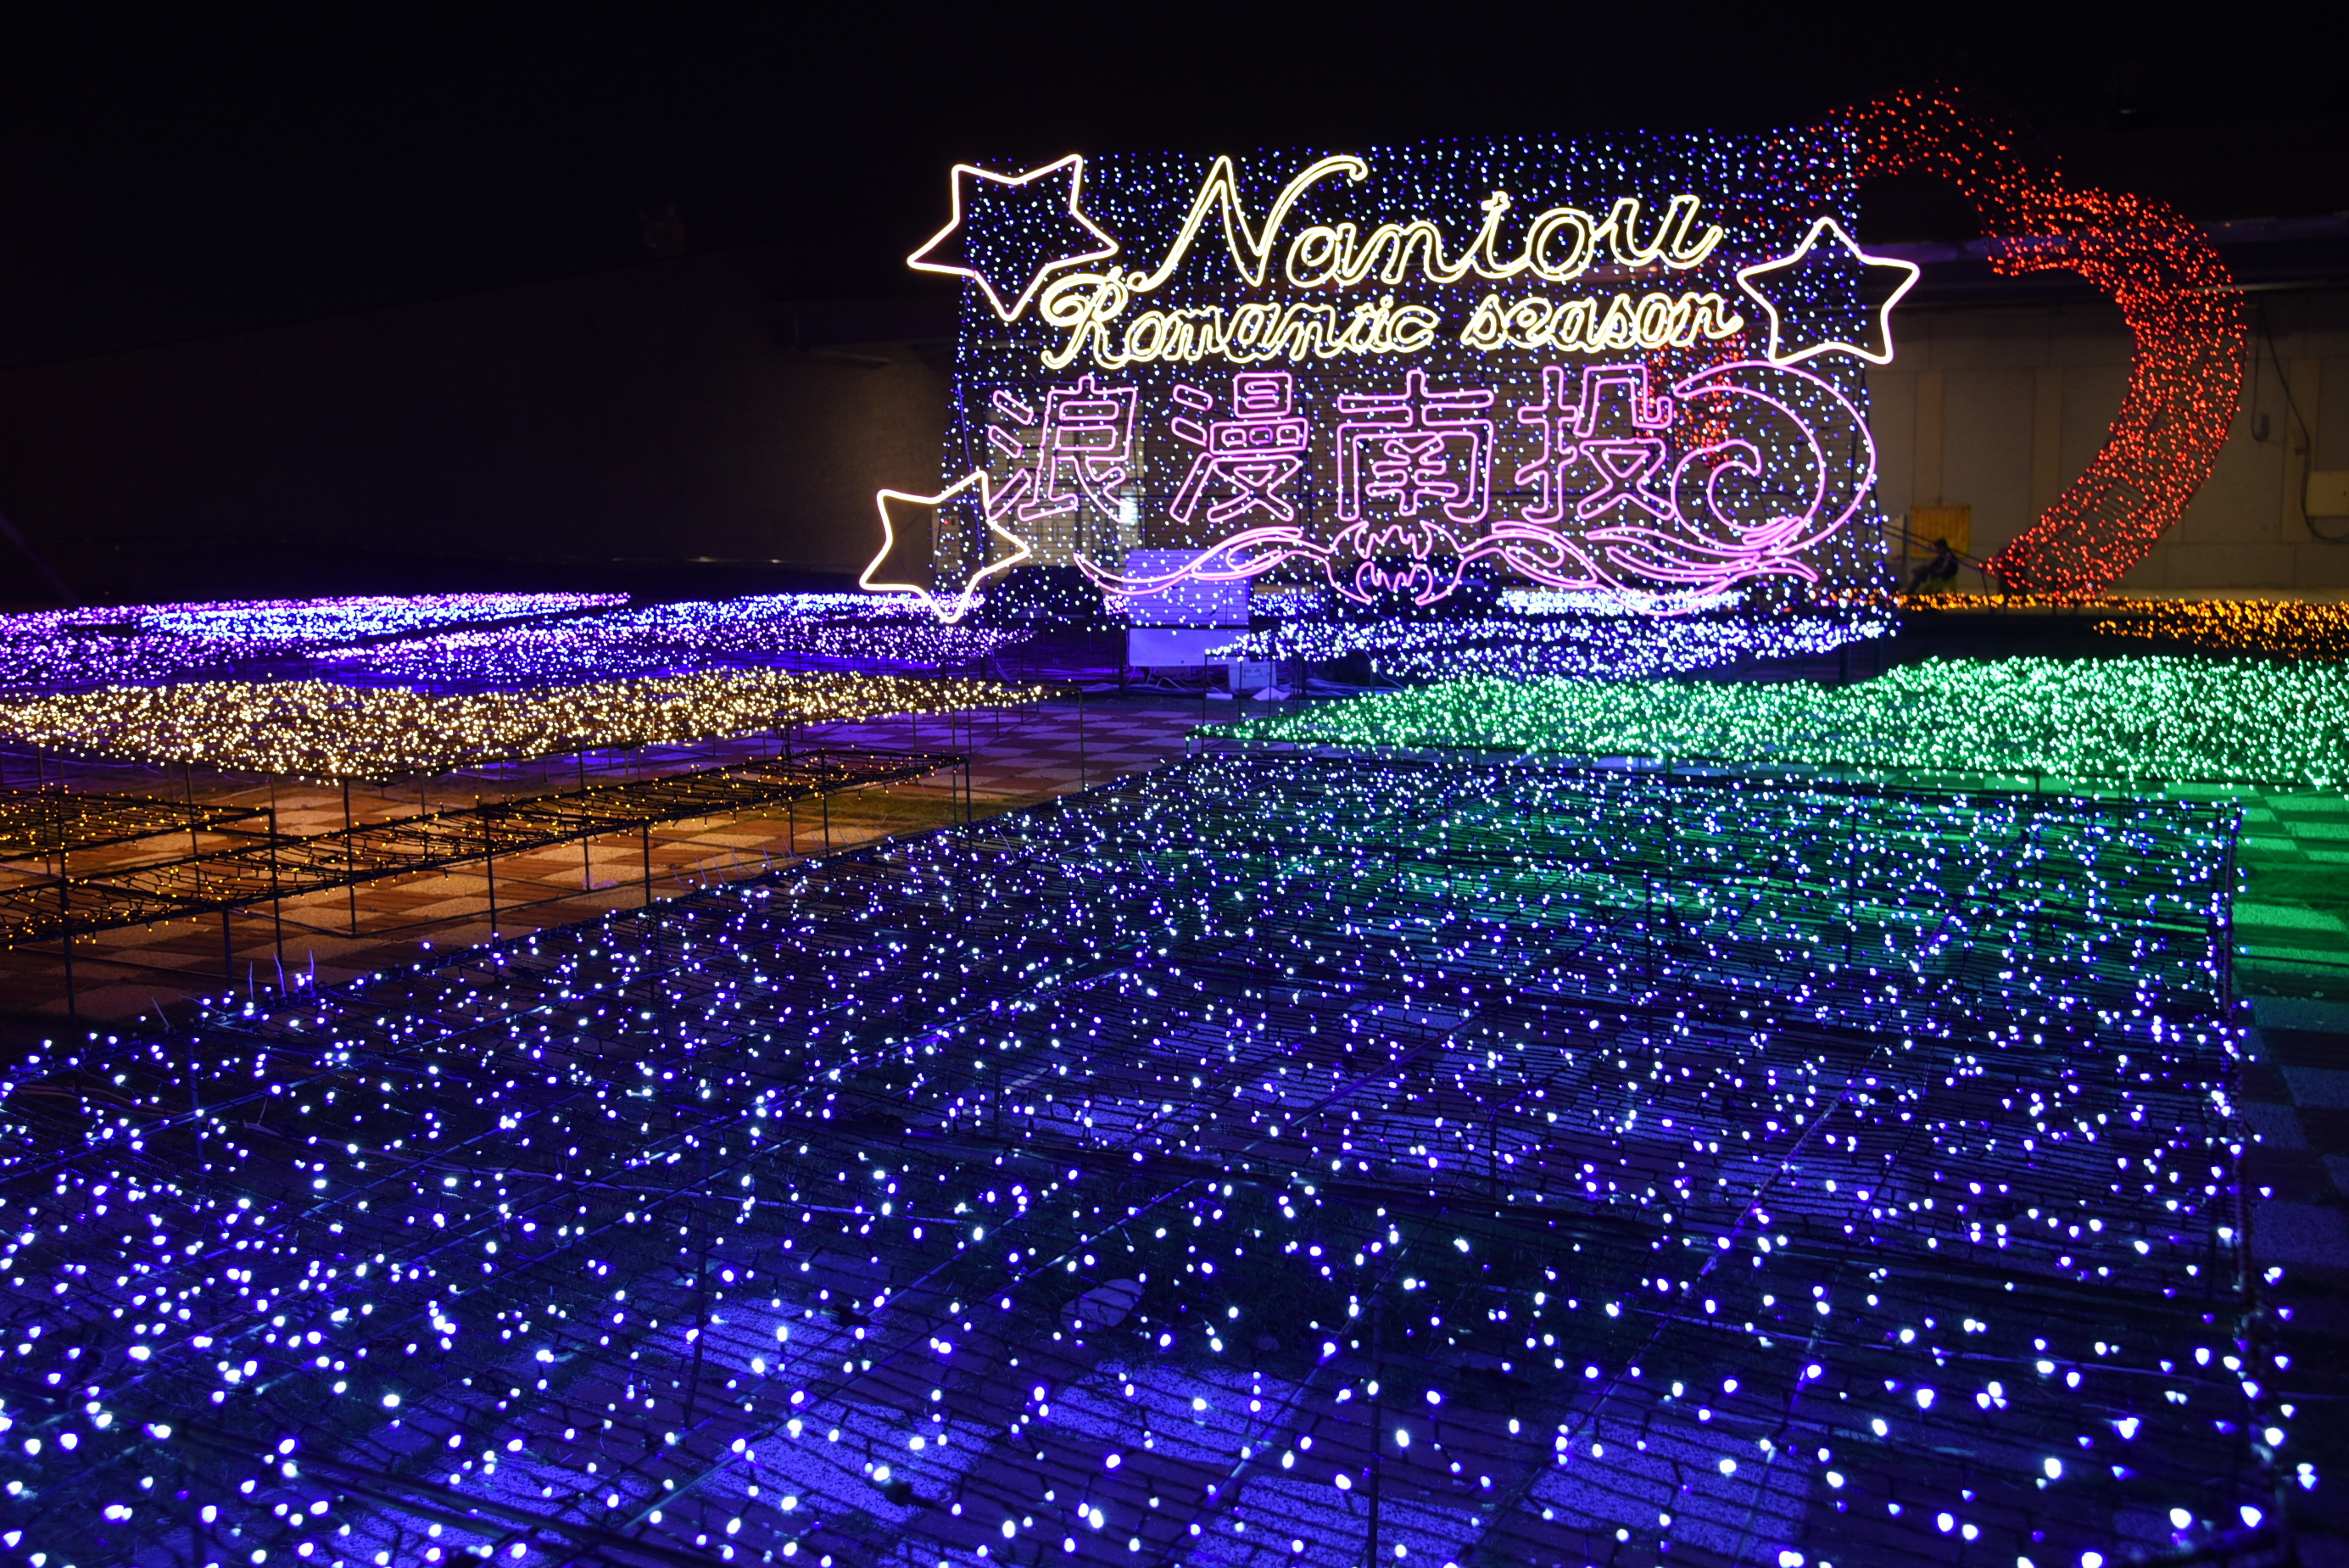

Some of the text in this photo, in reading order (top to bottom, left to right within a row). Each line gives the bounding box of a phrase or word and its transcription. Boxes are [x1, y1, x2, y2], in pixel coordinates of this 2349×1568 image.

[1040, 266, 1744, 370] Romantic season
[988, 365, 1676, 524] 浪漫南投
